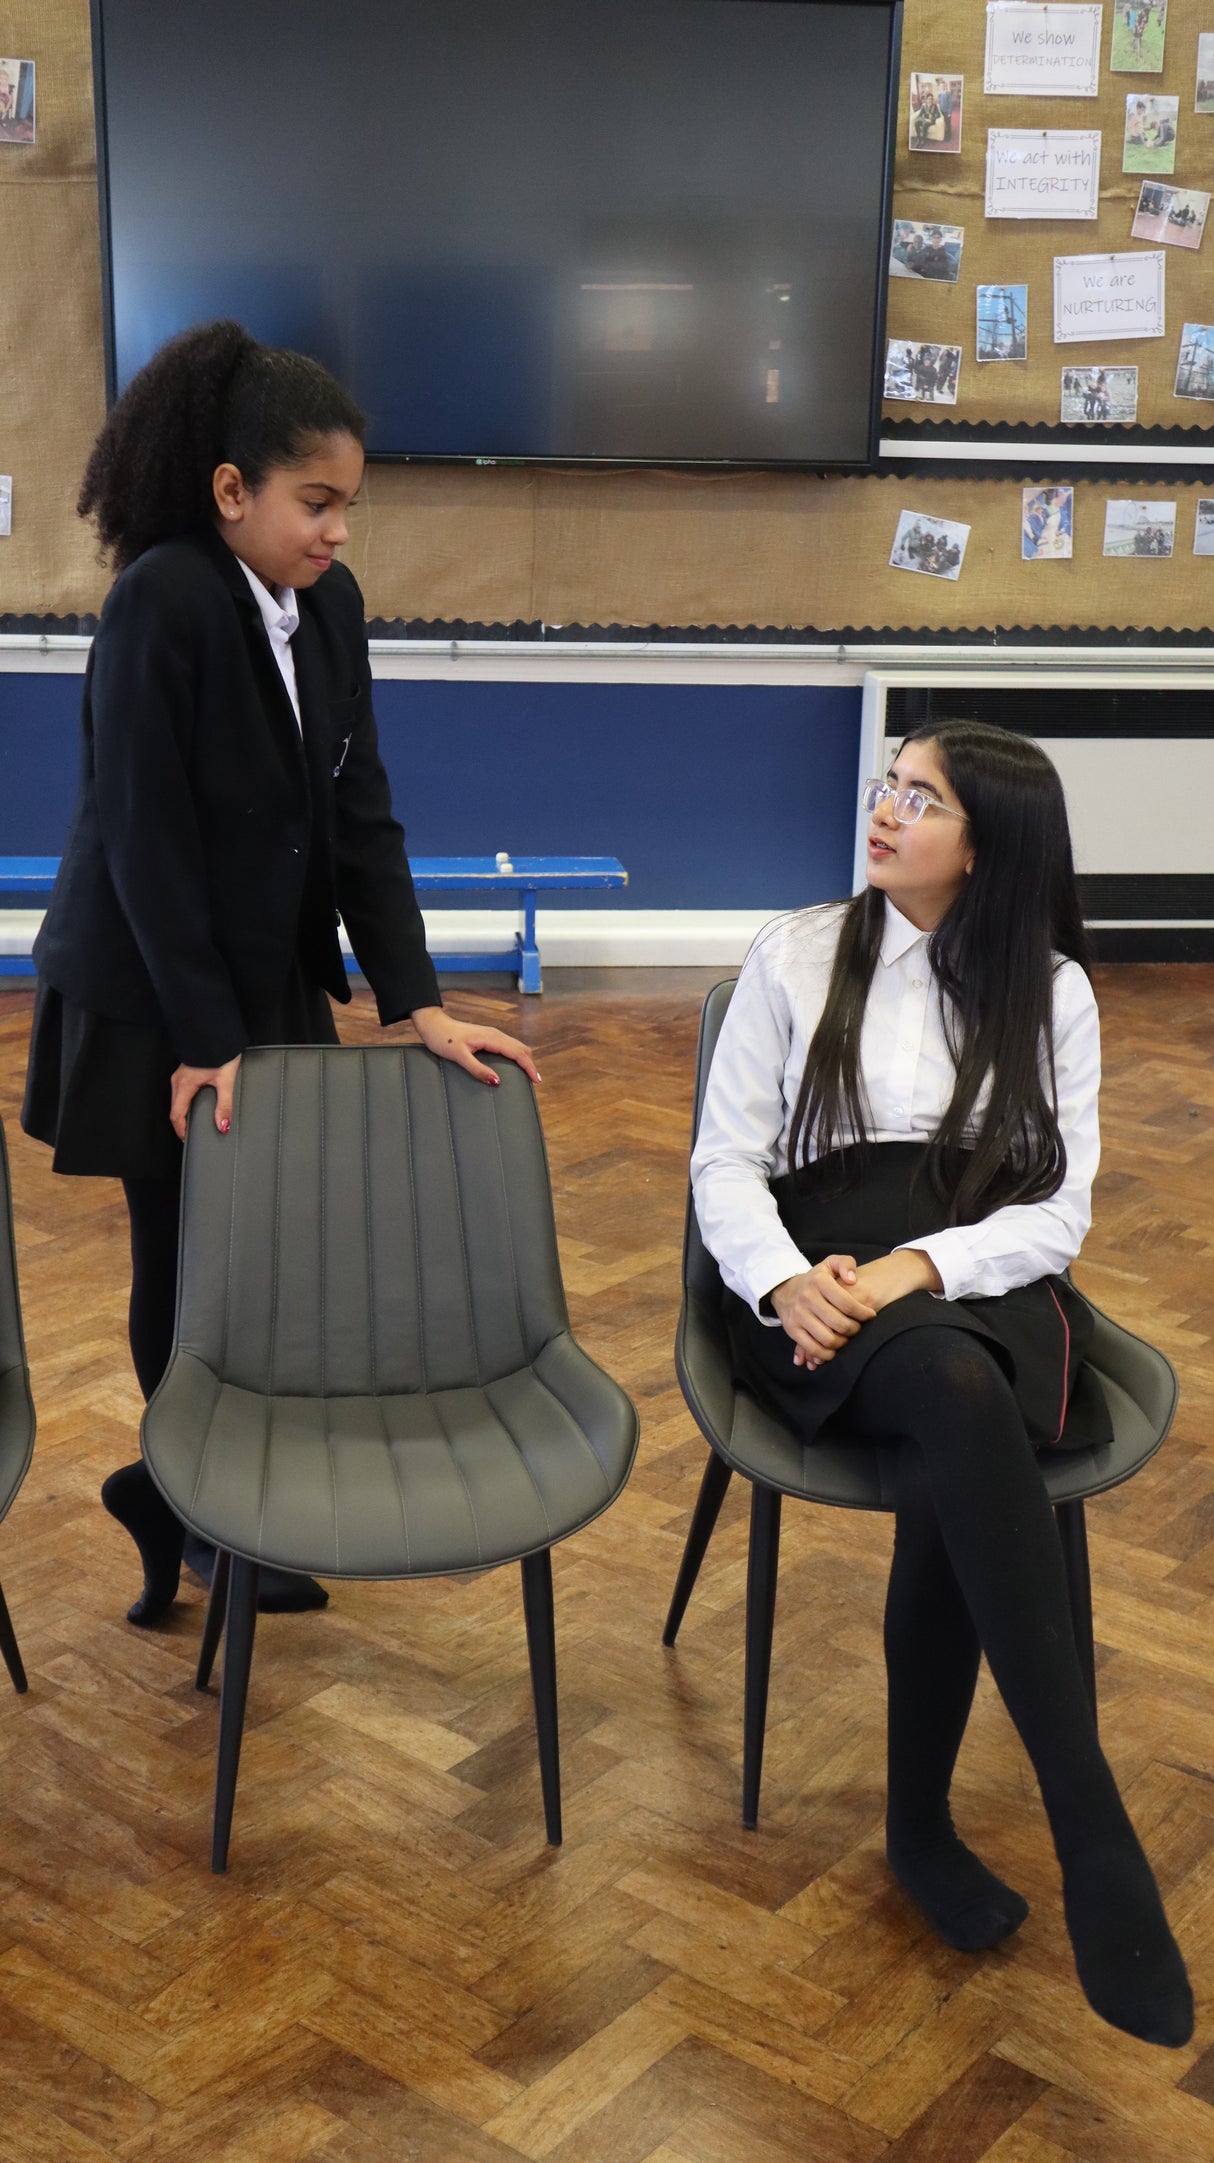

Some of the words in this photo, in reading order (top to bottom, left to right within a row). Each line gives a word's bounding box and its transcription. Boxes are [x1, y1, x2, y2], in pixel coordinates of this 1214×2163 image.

[1012, 31, 1032, 44] We
[1037, 28, 1076, 45] show
[992, 55, 1092, 67] DETERMINATION
[996, 150, 1017, 164] We
[1022, 150, 1050, 165] act
[1054, 149, 1091, 166] with
[995, 176, 1089, 193] INTEGRITY
[1083, 275, 1104, 288] We
[1109, 274, 1136, 287] are
[1063, 296, 1157, 316] NURTURING
